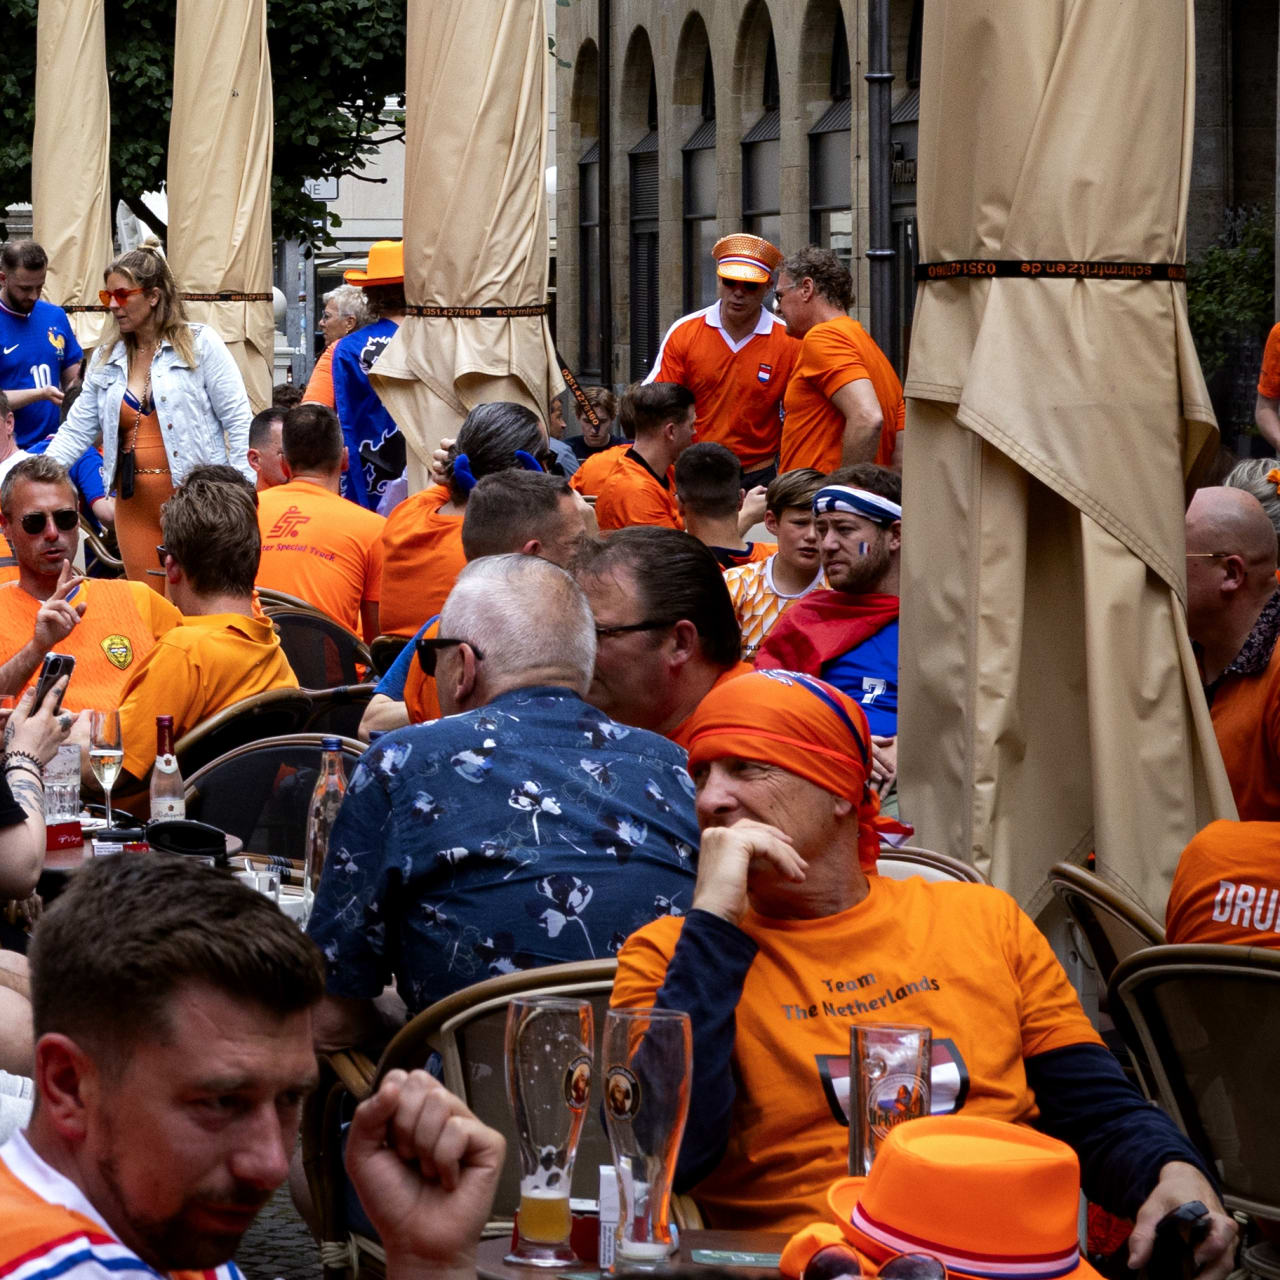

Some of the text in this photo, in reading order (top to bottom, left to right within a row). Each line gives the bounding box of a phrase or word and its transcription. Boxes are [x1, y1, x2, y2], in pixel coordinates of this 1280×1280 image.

[1021, 262, 1152, 277] schirmfritzen.de
[30, 363, 52, 390] 10
[861, 677, 887, 704] 7
[1211, 879, 1280, 934] DRU
[822, 972, 877, 993] Team
[781, 975, 941, 1020] The Netherlands
